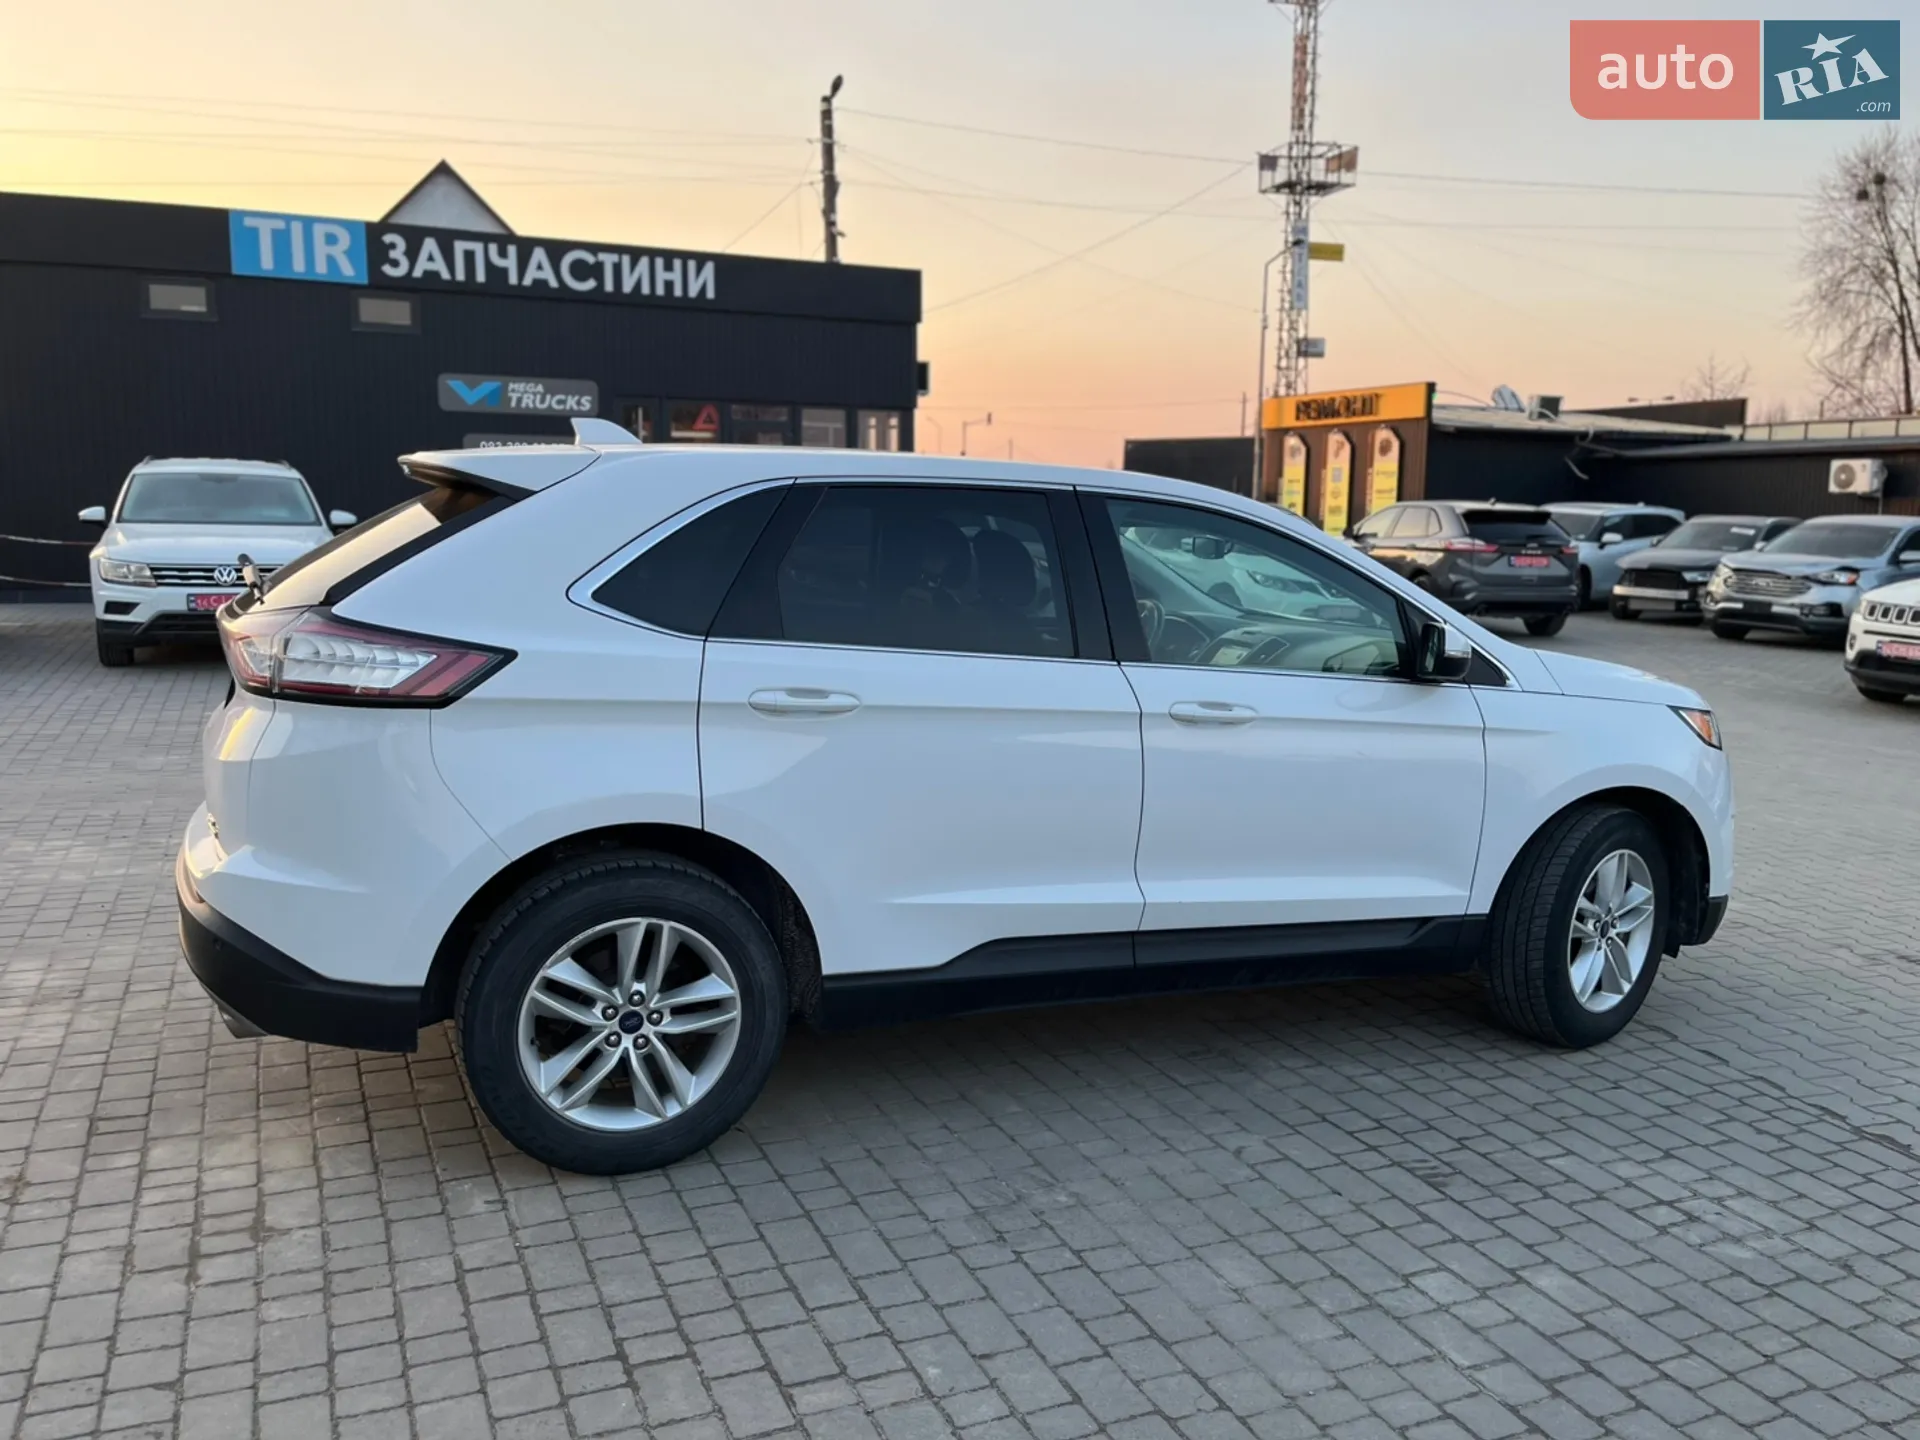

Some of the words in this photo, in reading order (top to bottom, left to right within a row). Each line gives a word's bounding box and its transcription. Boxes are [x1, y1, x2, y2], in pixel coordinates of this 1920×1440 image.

[243, 216, 356, 277] TIR
[380, 232, 716, 301] ЗАПЧАСТИНИ
[507, 381, 545, 393] MEGA
[508, 392, 592, 411] TRUCKS
